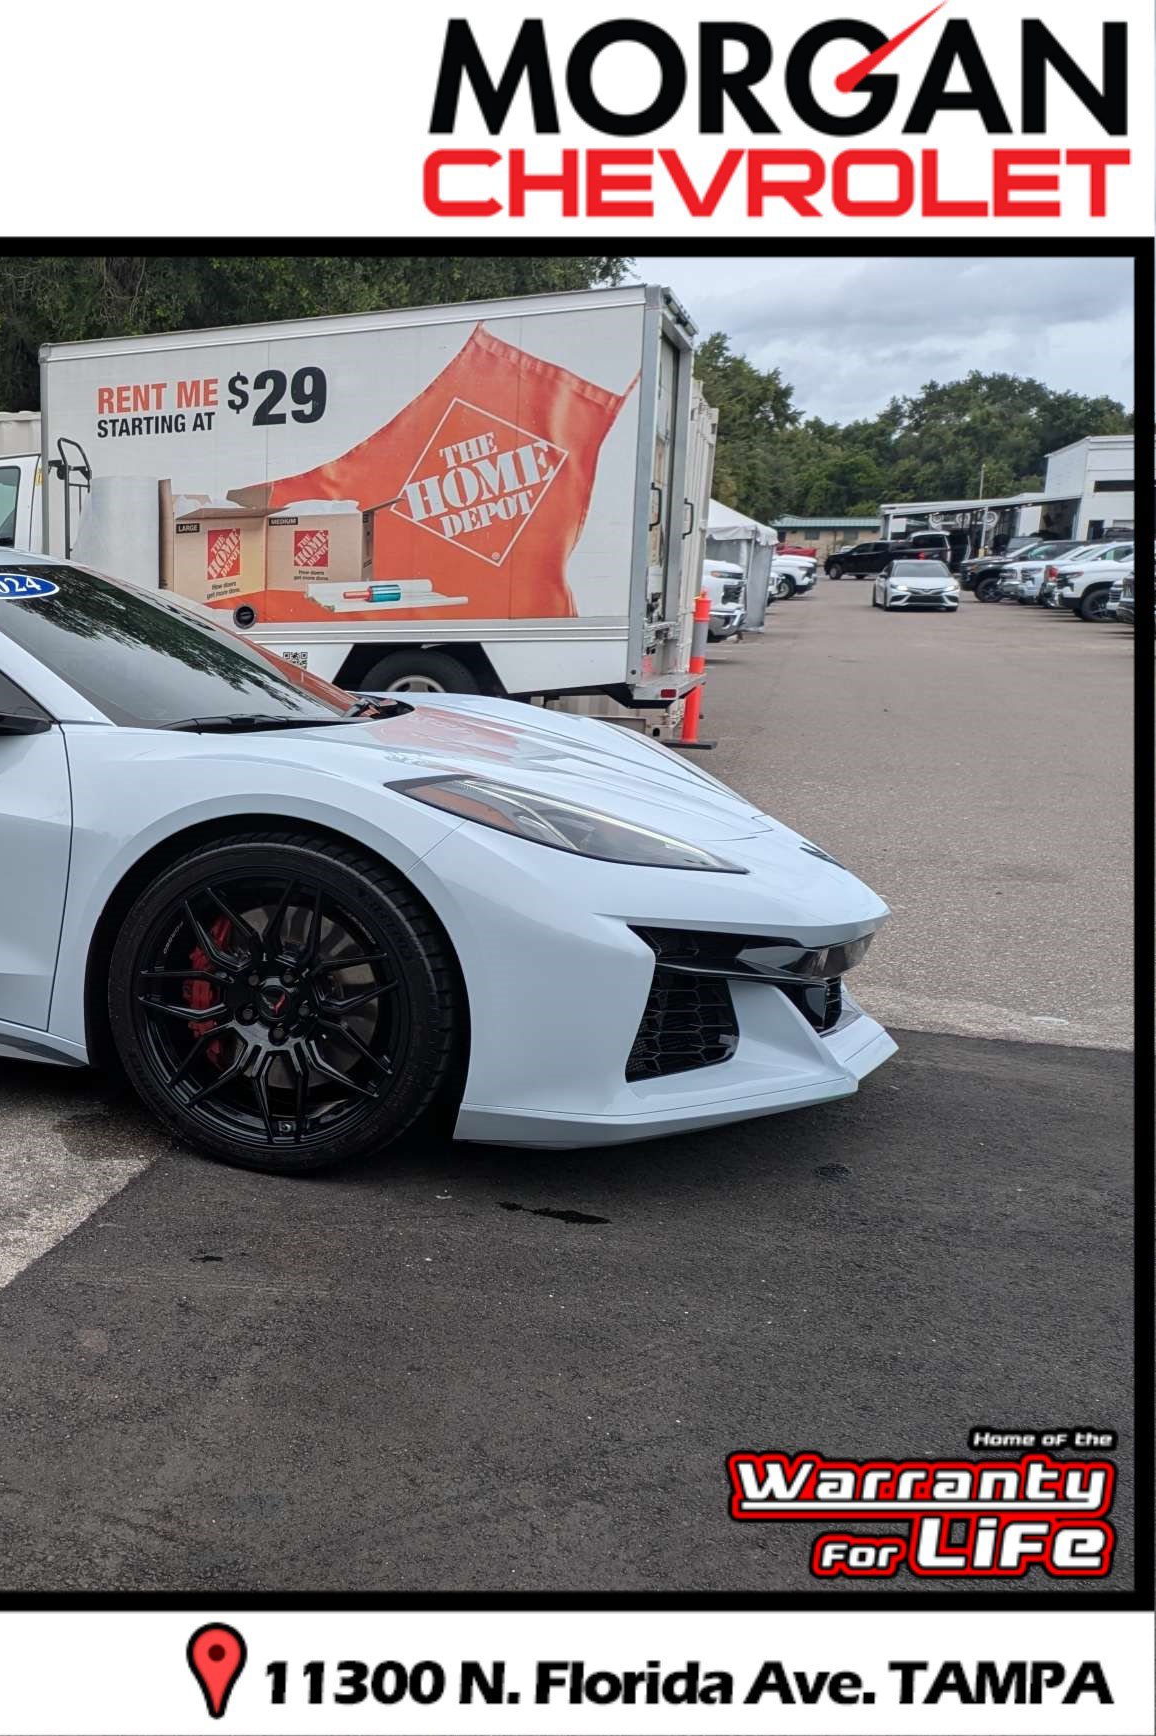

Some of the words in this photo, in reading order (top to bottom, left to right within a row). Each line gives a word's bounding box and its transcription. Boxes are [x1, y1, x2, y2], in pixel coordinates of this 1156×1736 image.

[98, 383, 167, 414] RENT
[177, 379, 219, 408] ME
[228, 366, 327, 427] $29
[97, 413, 186, 438] STARTING
[192, 412, 215, 432] AT
[439, 432, 498, 469] THE
[404, 439, 555, 522] HOME
[177, 524, 199, 533] LARGE
[271, 517, 297, 526] MEDIUM
[440, 490, 533, 538] DEPOT
[208, 530, 240, 578] HOME
[294, 530, 328, 566] HOME
